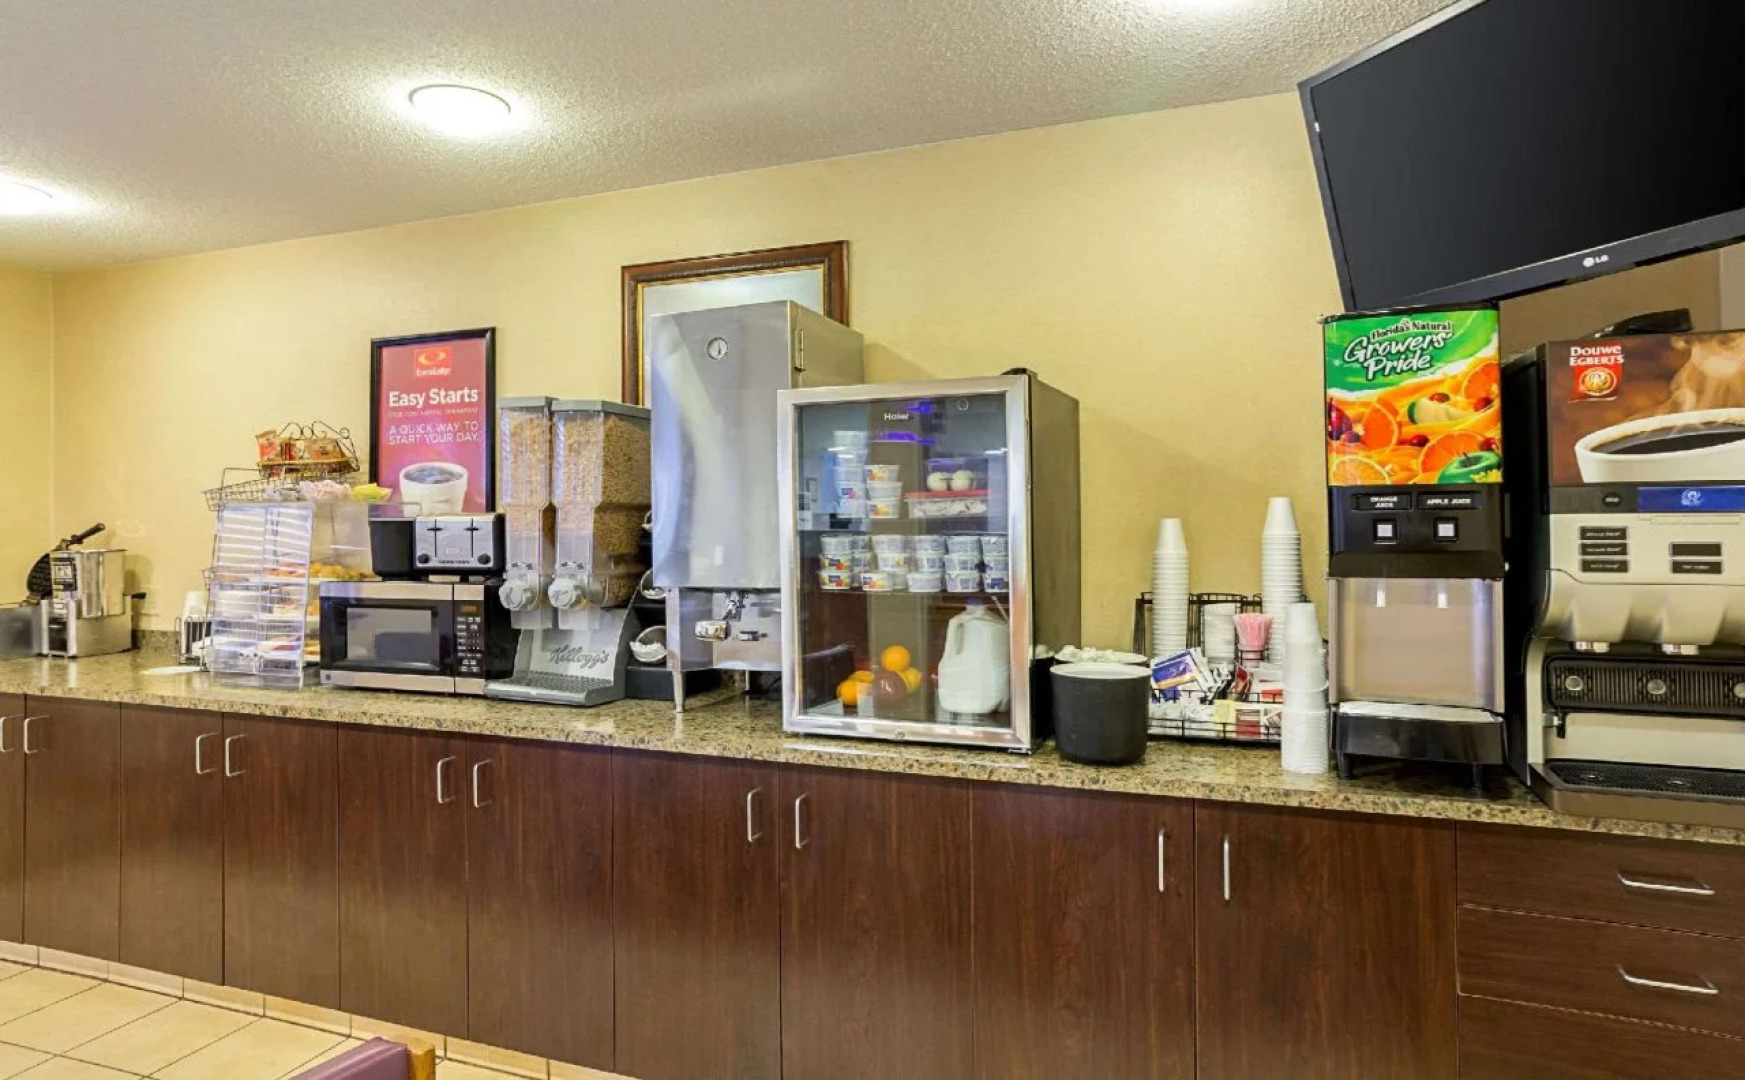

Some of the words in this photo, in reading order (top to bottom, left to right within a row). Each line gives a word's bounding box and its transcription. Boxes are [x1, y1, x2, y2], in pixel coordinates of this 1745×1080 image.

[1412, 321, 1453, 332] Natural
[1363, 349, 1431, 380] Pride
[1569, 353, 1625, 366] EGBERTS
[389, 391, 425, 408] Easy
[429, 387, 479, 405] Starts
[389, 425, 396, 435] A
[400, 423, 433, 435] QUICK
[436, 421, 460, 433] WAY
[462, 420, 479, 432] TO
[389, 433, 421, 446] START
[423, 432, 453, 444] YOUR
[549, 644, 610, 669] Kellogg's
